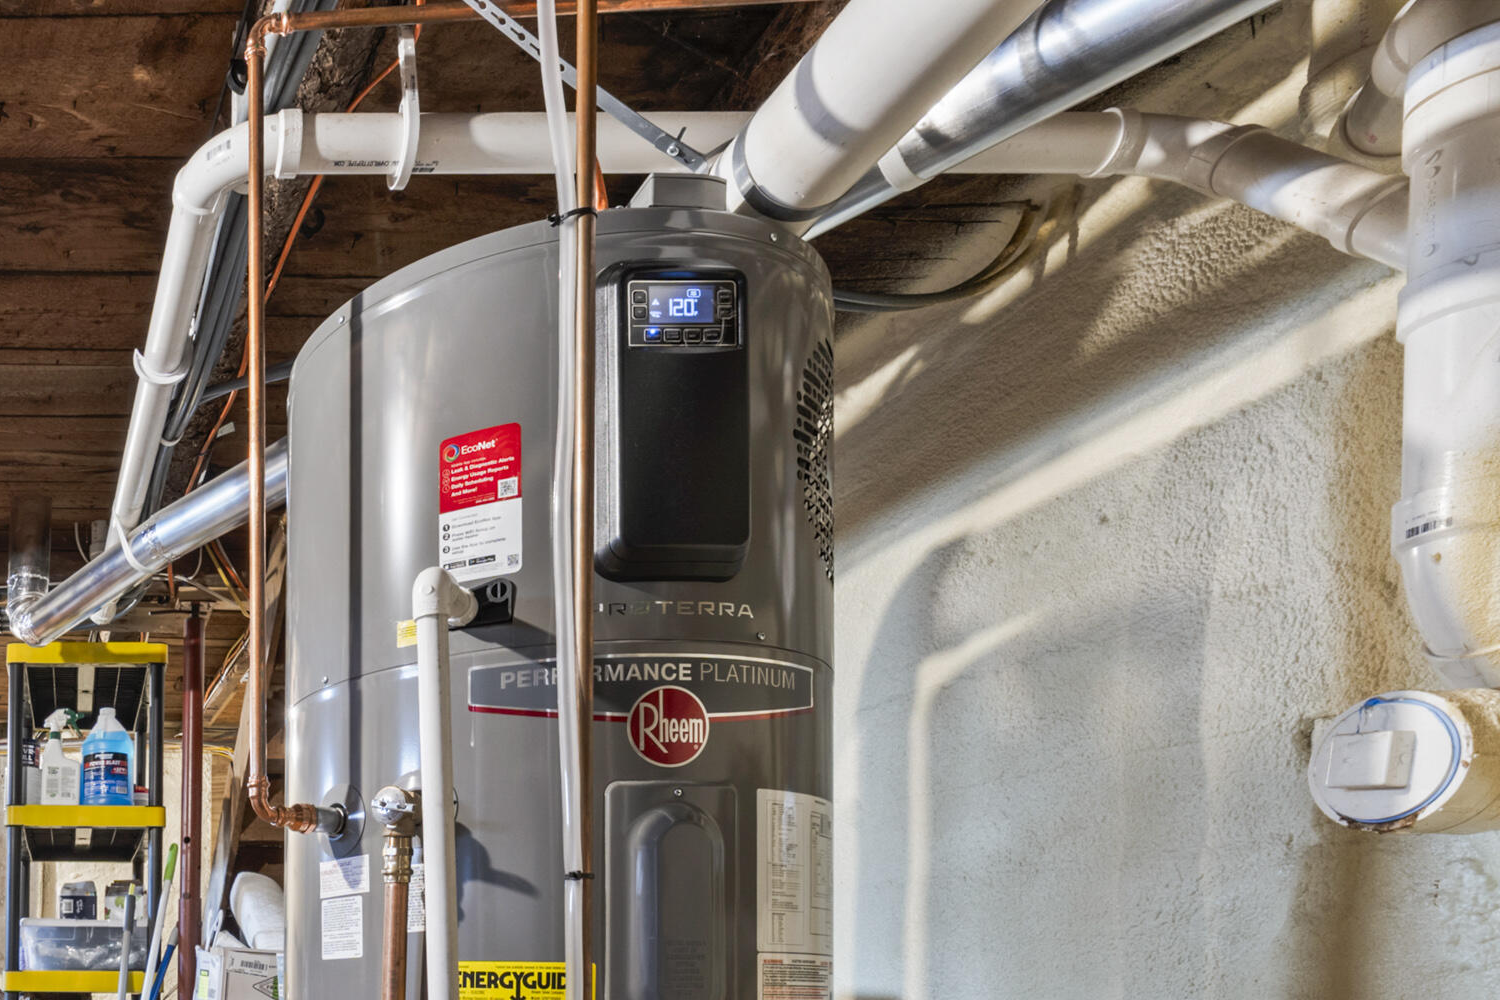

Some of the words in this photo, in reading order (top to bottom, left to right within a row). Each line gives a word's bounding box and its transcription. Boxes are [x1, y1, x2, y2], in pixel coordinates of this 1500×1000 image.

[461, 439, 496, 455] EcoNet
[700, 662, 795, 689] PLATINUM
[639, 688, 704, 753] Rheem
[458, 971, 566, 991] NERGYGUID
